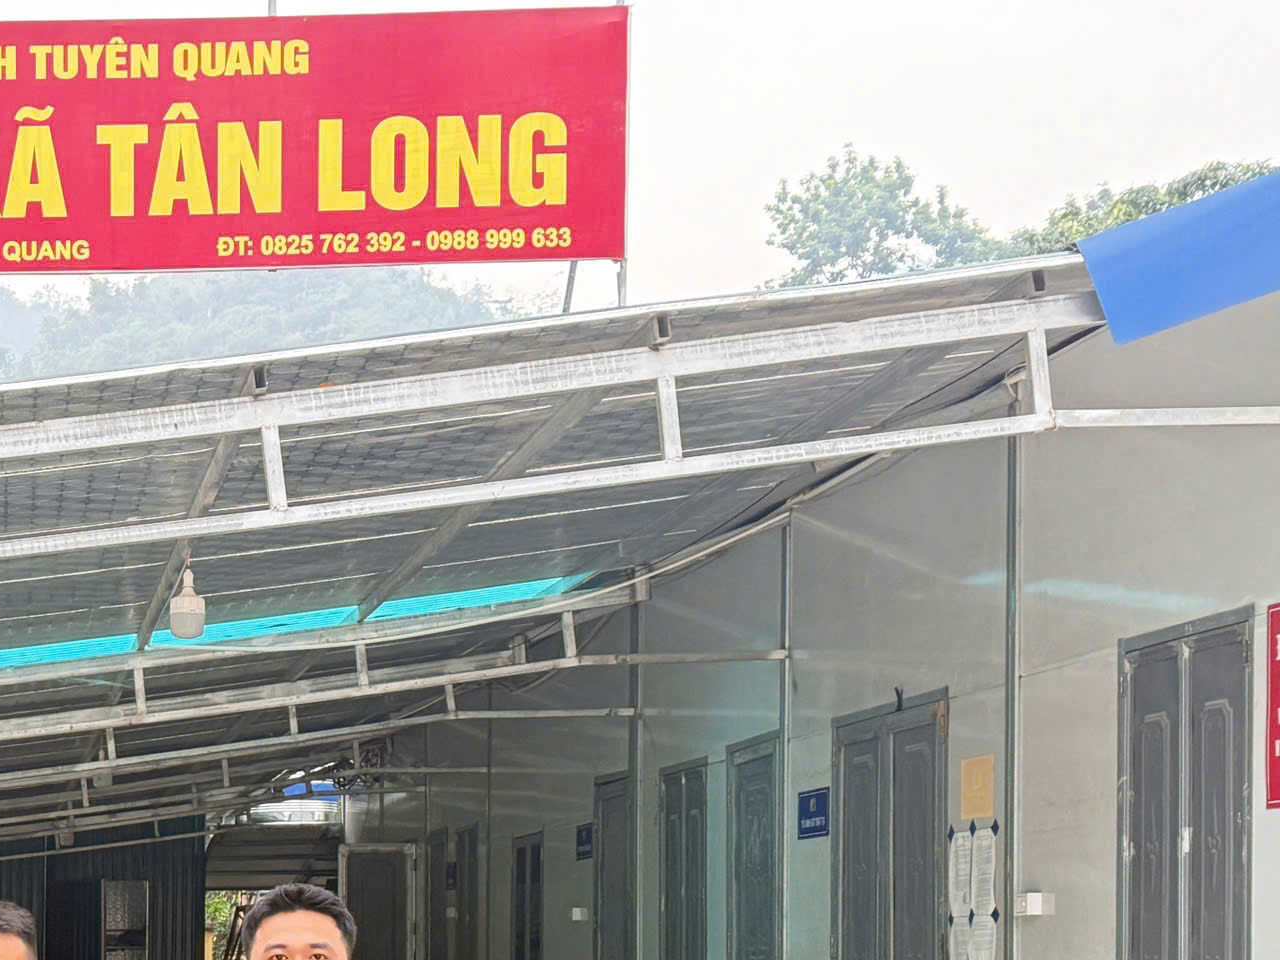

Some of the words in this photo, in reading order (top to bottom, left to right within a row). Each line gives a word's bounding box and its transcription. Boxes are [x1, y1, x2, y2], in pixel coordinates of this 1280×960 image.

[29, 37, 159, 80] TUYÊN
[172, 39, 310, 79] QUANG
[96, 103, 283, 217] TÂN
[317, 112, 572, 212] LONG
[3, 239, 90, 263] QUANG
[216, 235, 253, 257] ĐT:
[260, 234, 314, 256] 0825
[320, 233, 360, 255] 762
[365, 231, 406, 254] 392
[425, 229, 480, 251] 0988
[485, 228, 526, 250] 999
[531, 226, 572, 249] 633
